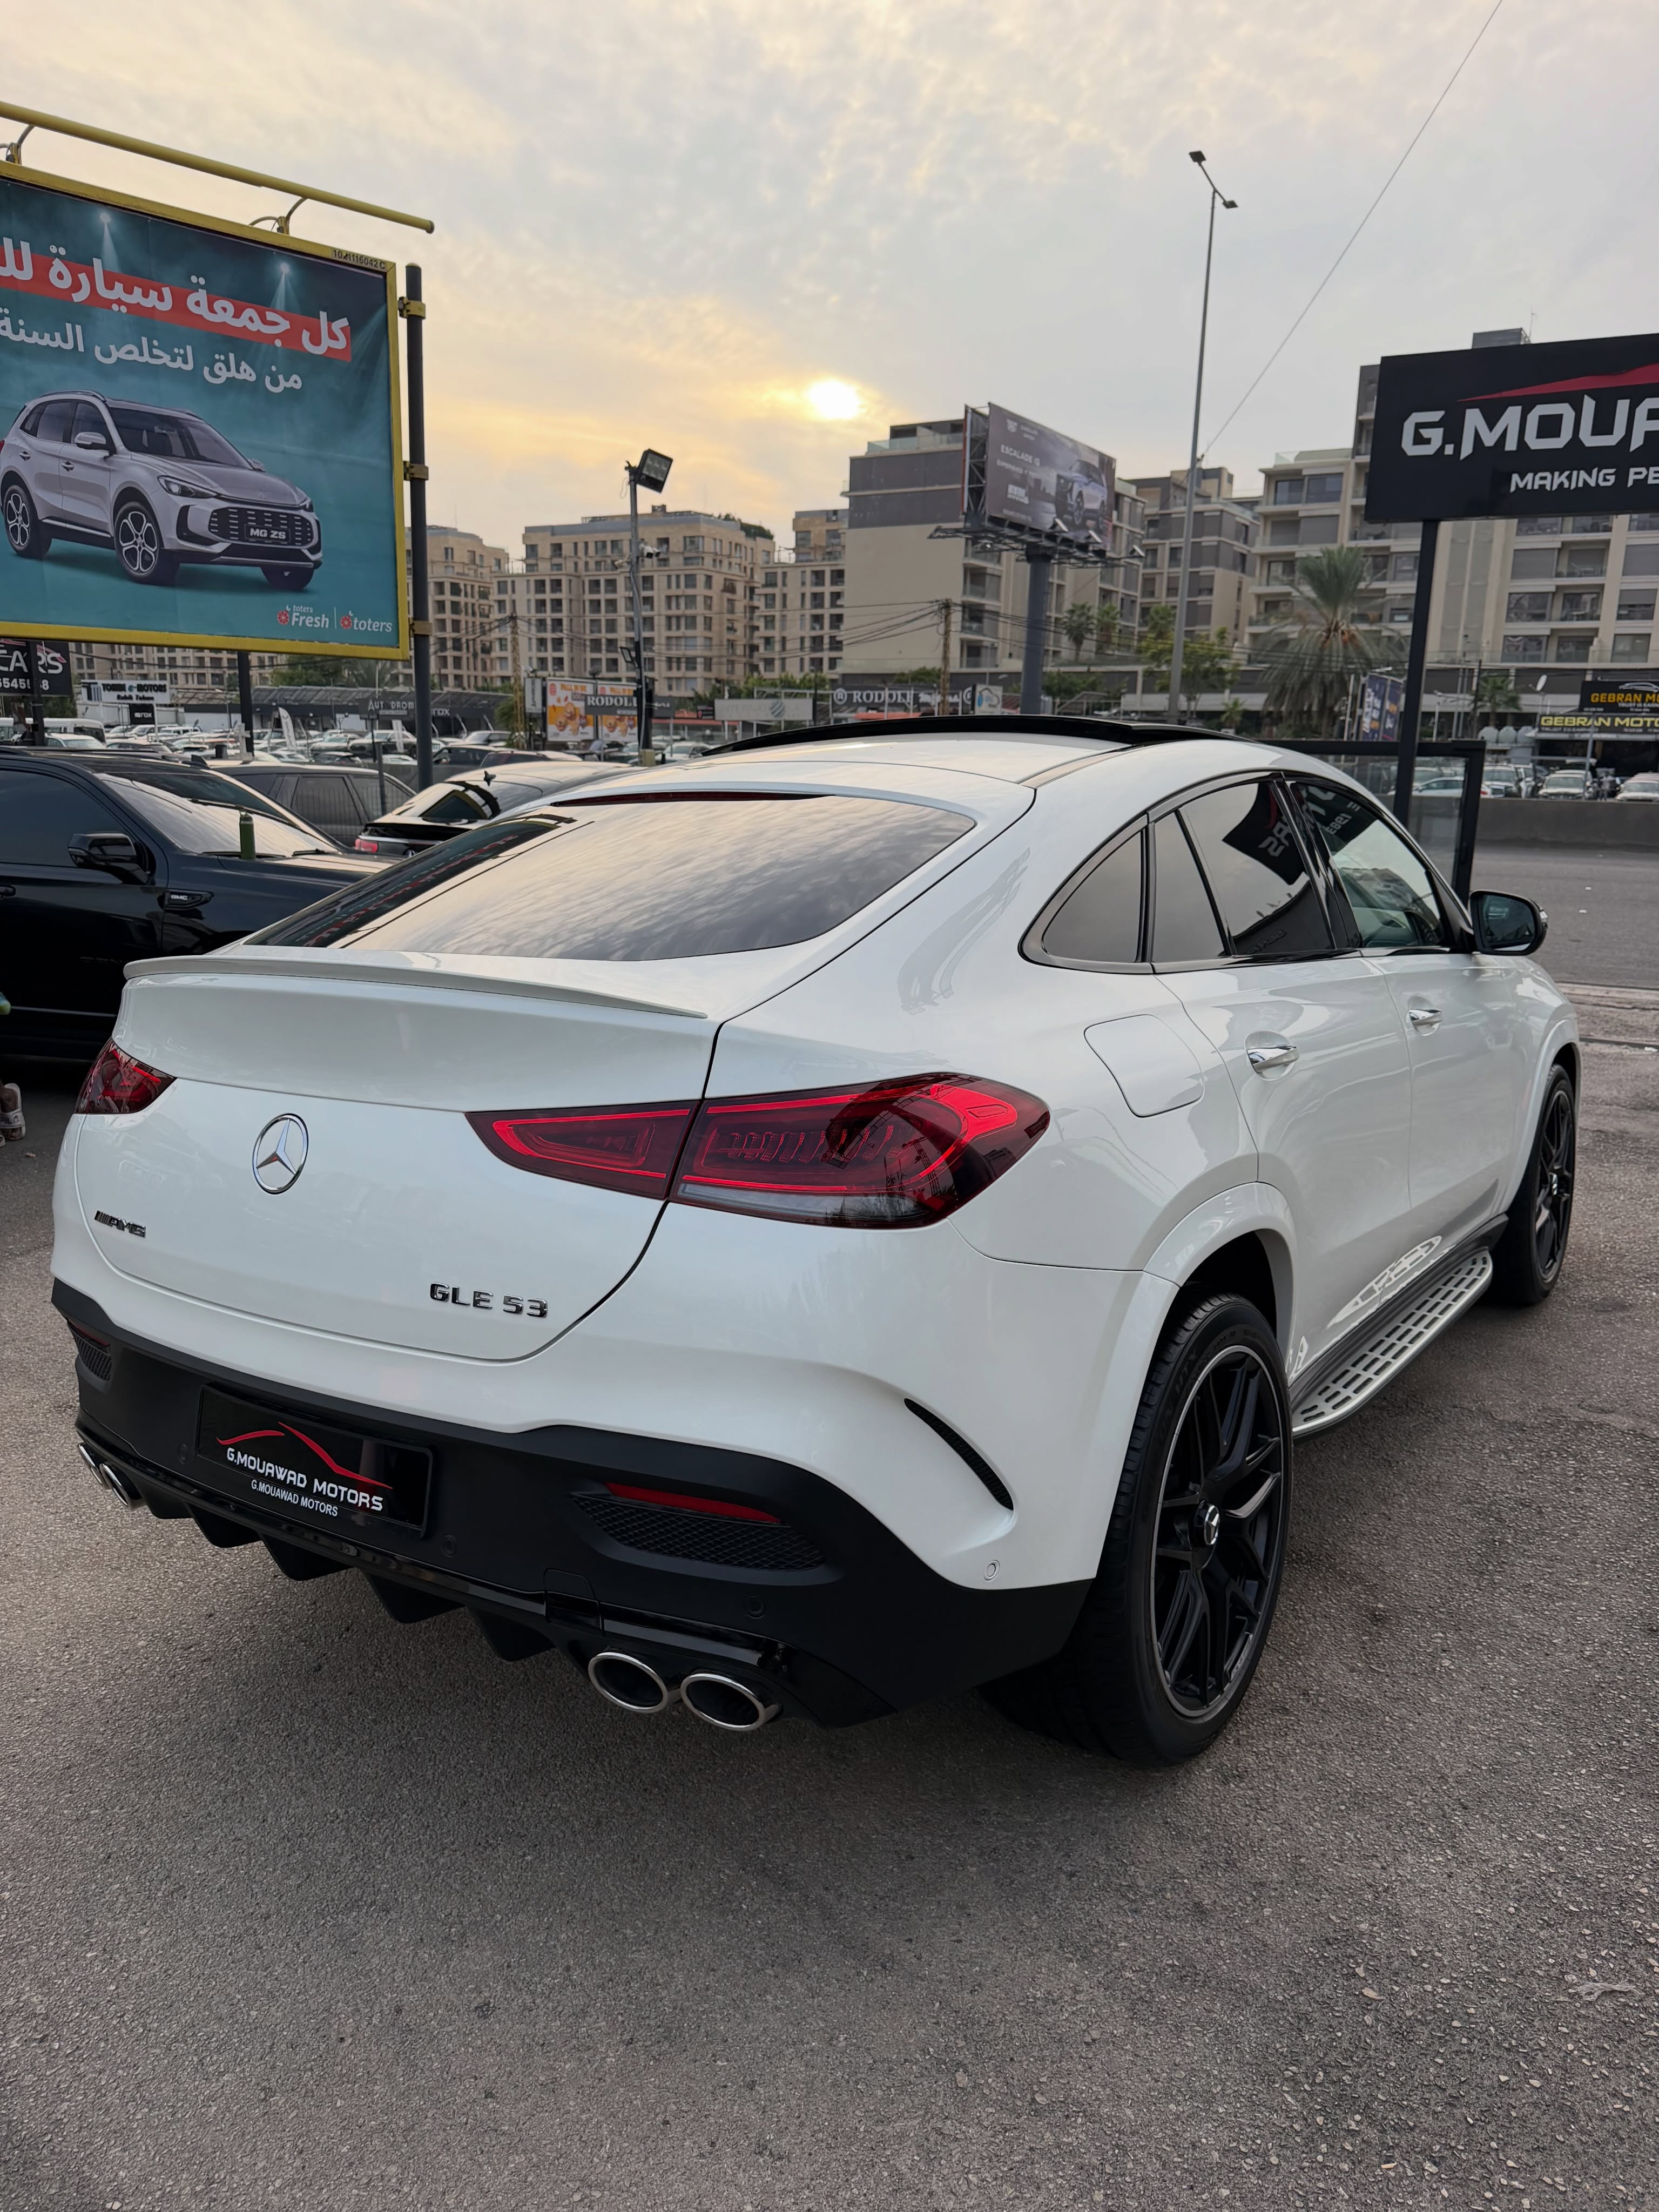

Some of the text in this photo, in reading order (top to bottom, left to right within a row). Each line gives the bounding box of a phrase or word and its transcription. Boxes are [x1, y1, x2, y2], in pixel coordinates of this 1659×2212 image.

[49, 245, 173, 313] سيارة
[187, 275, 290, 347] جمعة
[302, 311, 349, 355] كل
[0, 307, 302, 393] من هلق لتخلص السنة
[1510, 467, 1616, 493] MAKING
[250, 528, 286, 539] MG ZS
[291, 612, 393, 632] Fresh toters
[293, 604, 314, 613] toters
[1590, 692, 1642, 703] GEBRAN
[1541, 716, 1611, 727] GEBRAN
[109, 1215, 146, 1238] AMG
[430, 1282, 548, 1318] GLE 53
[226, 1447, 383, 1512] G.MOUAWAD MOTORS
[251, 1479, 339, 1517] G.MOUAWAD MOTORS
